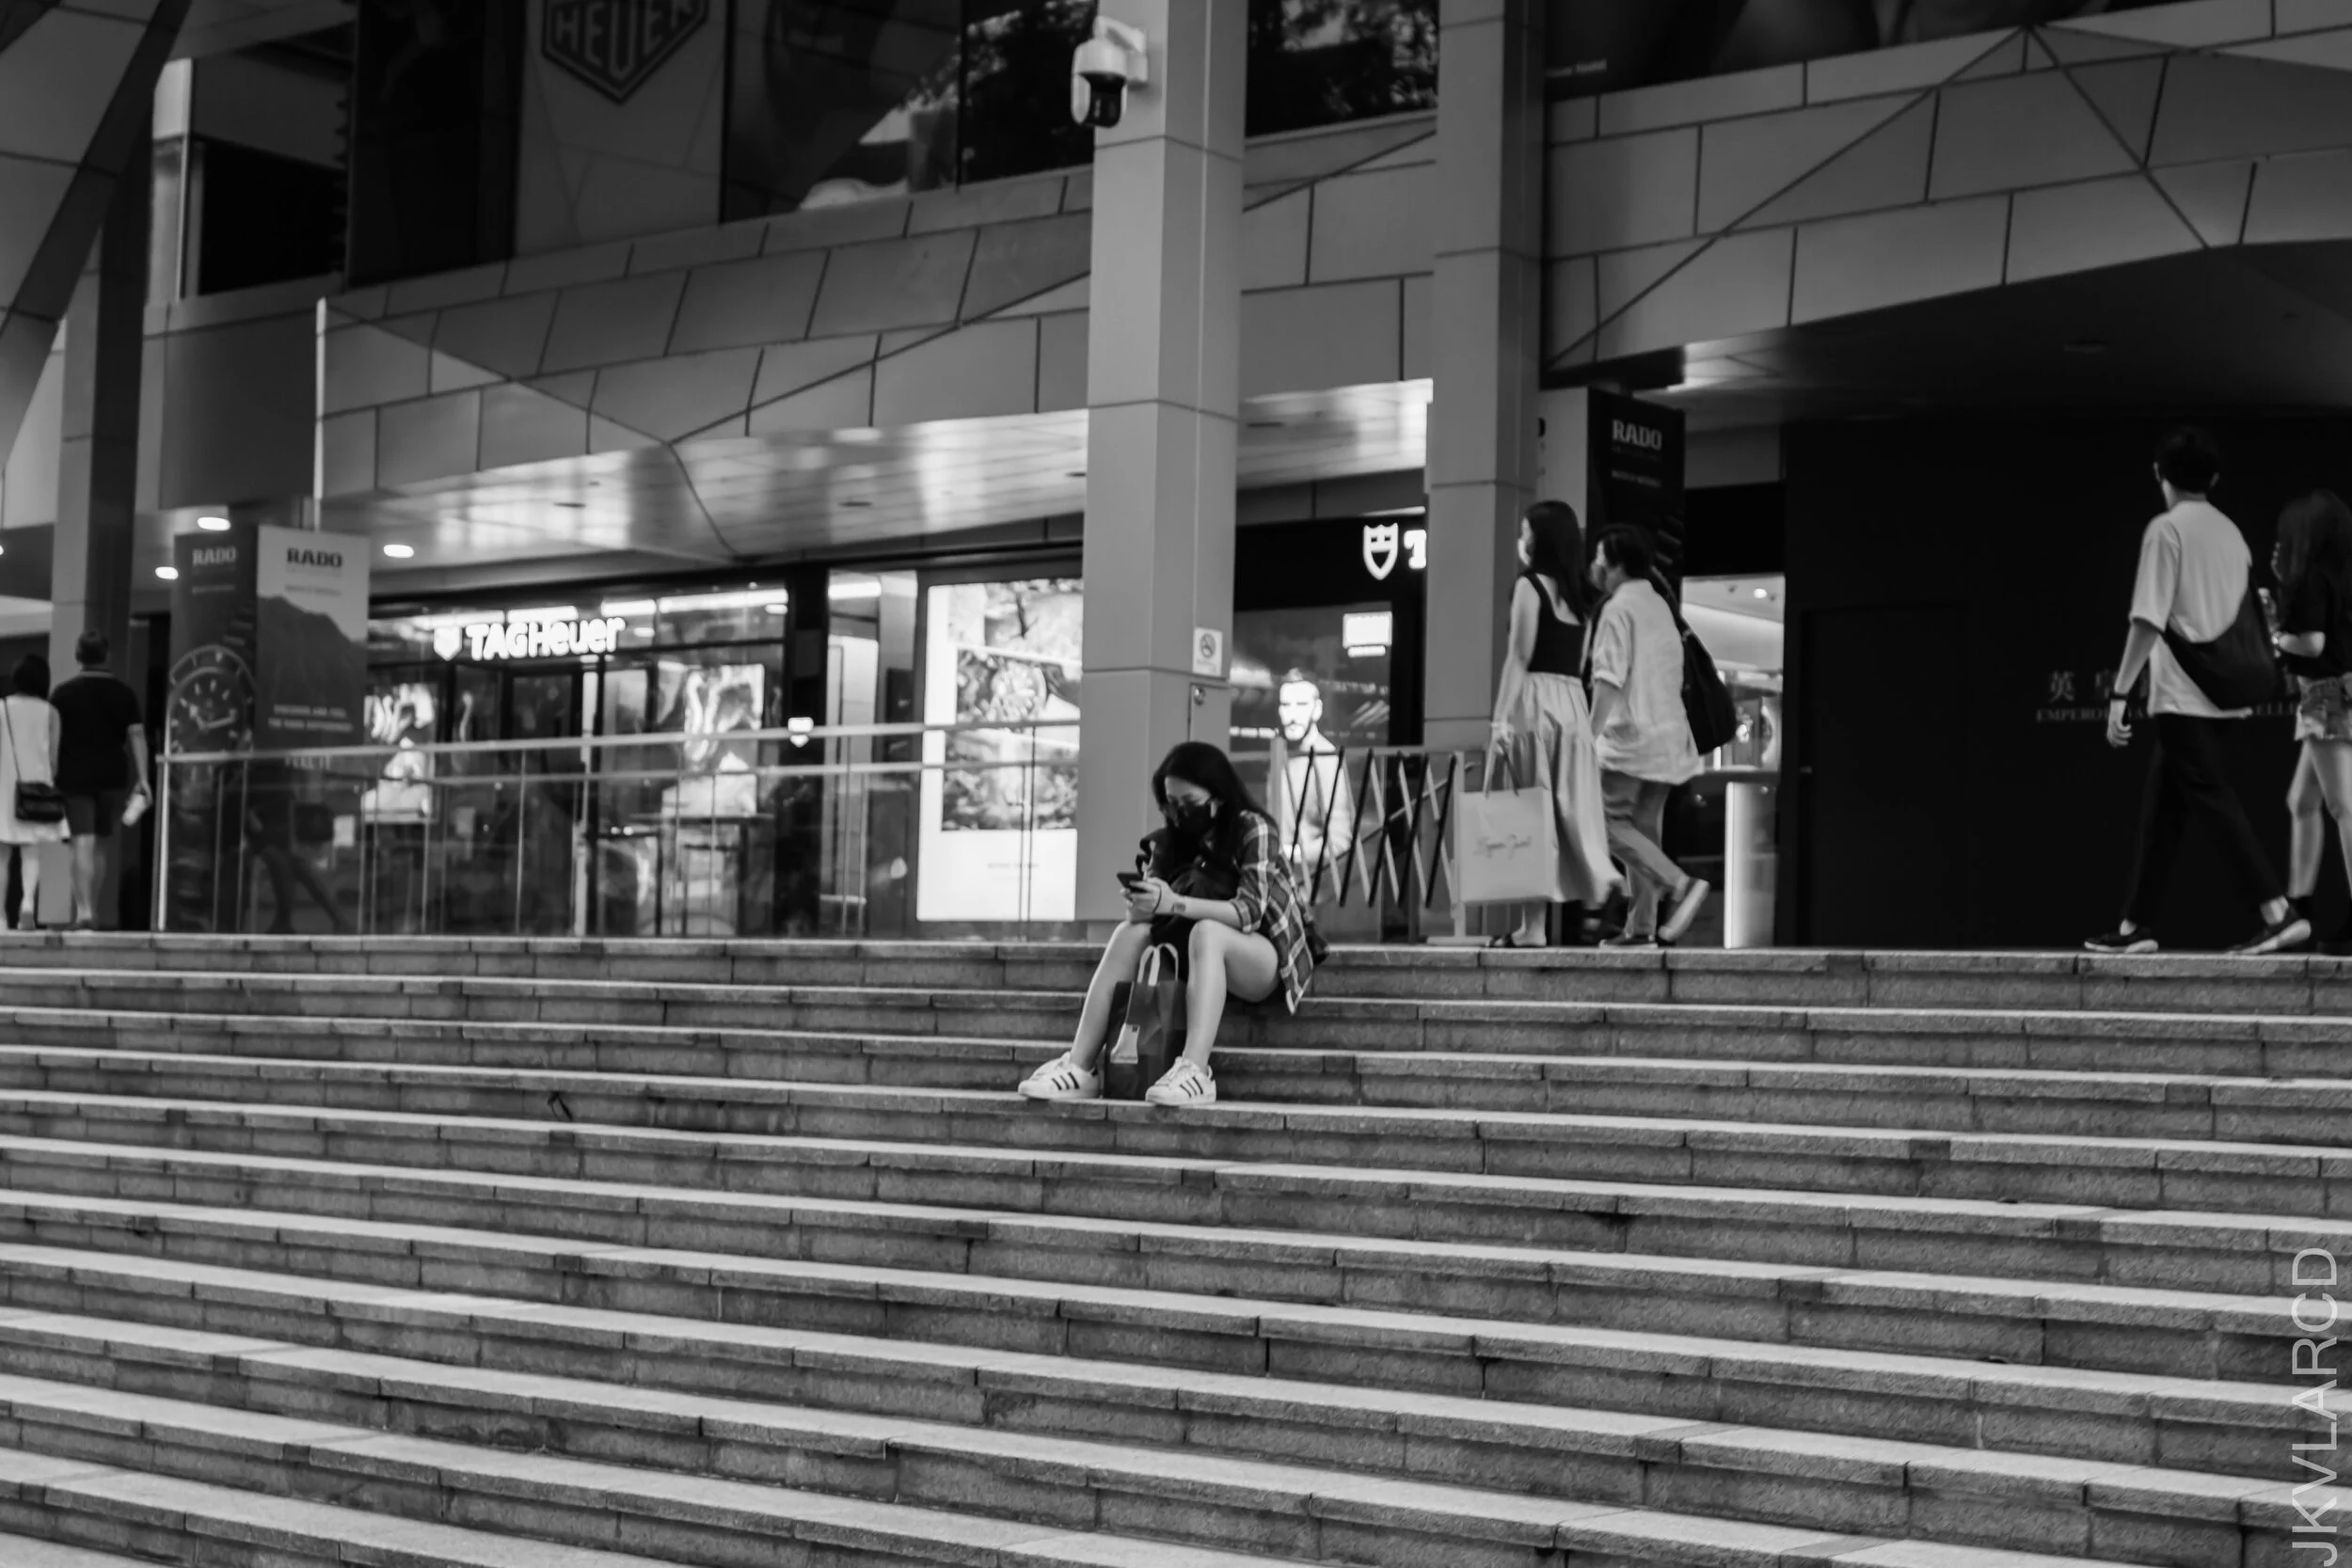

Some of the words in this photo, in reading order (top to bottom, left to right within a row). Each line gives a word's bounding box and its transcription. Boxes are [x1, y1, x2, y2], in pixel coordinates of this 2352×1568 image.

[1611, 419, 1663, 451] RADO
[191, 546, 237, 566] RADO
[285, 547, 342, 568] RADO
